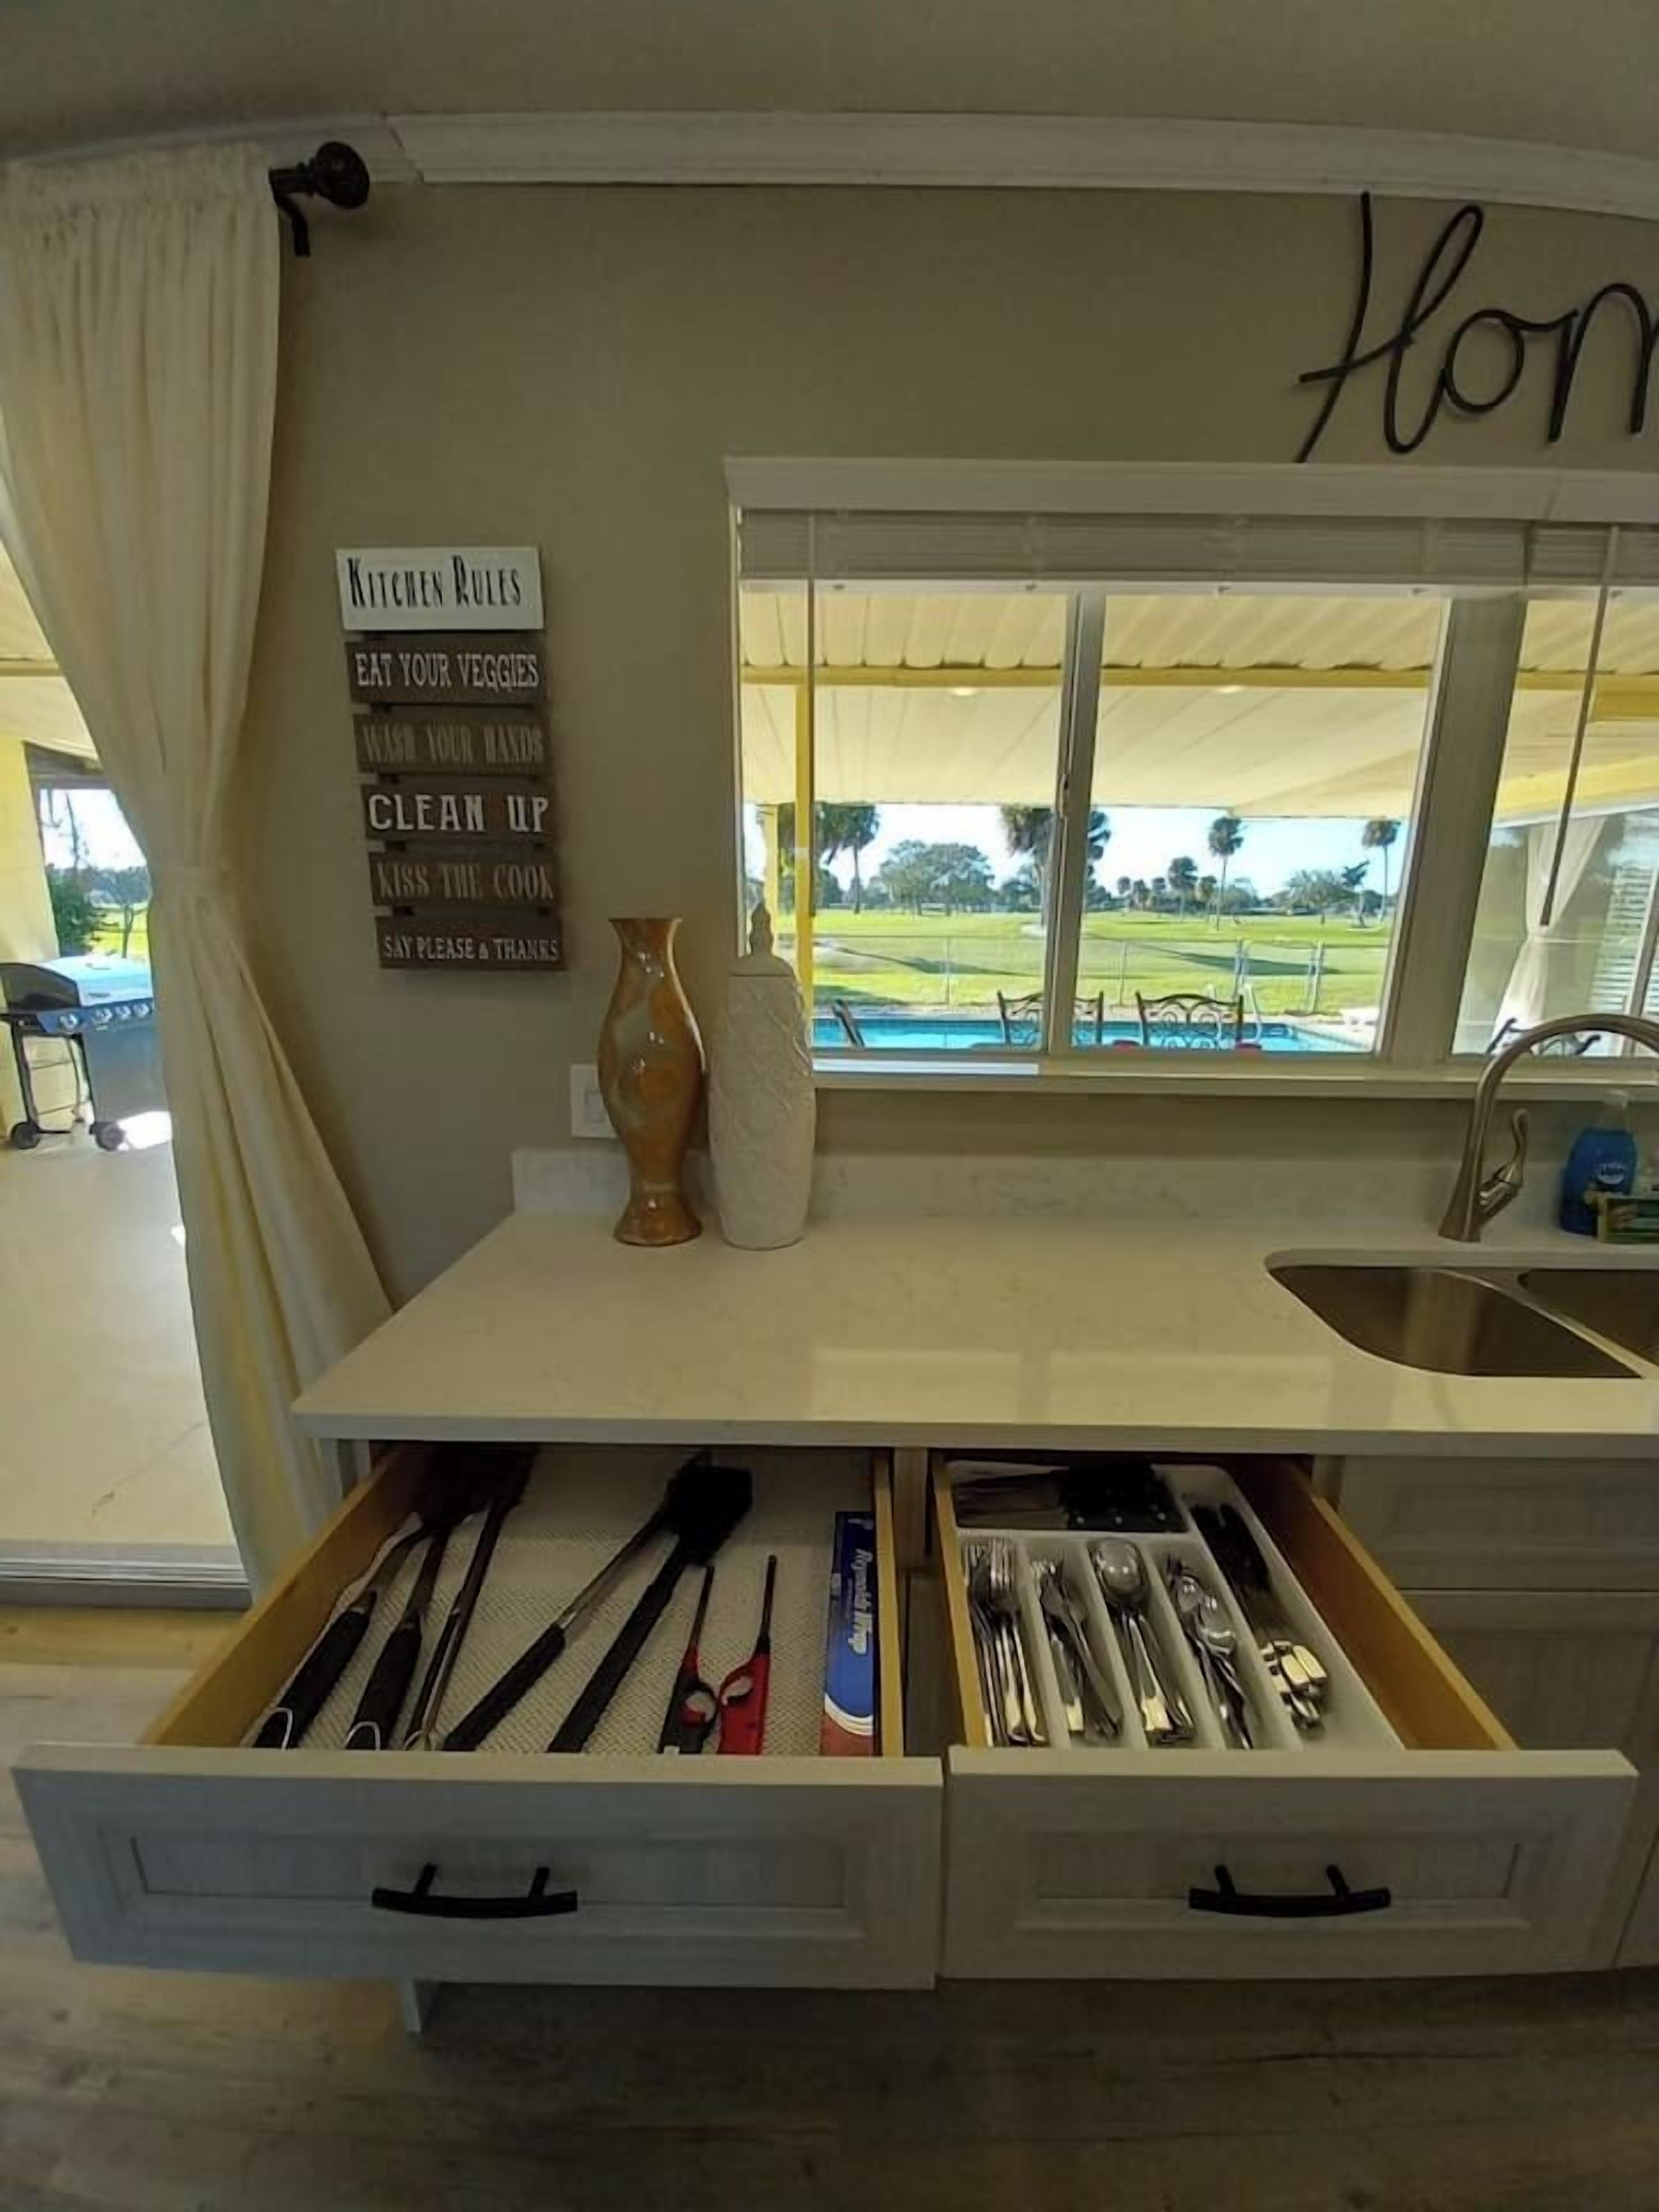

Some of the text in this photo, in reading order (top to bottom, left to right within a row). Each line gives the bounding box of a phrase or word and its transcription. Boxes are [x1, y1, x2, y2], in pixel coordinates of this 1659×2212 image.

[347, 554, 521, 608] KITCHEN RULES
[355, 653, 539, 691] EAT YOUR VEGGIES
[427, 725, 472, 764] YOUR
[369, 794, 548, 832] CLEAN UP
[377, 863, 554, 900] KISS THE COOK
[385, 935, 412, 959] SAY
[416, 937, 475, 959] PLEASE
[493, 938, 559, 960] THANKS
